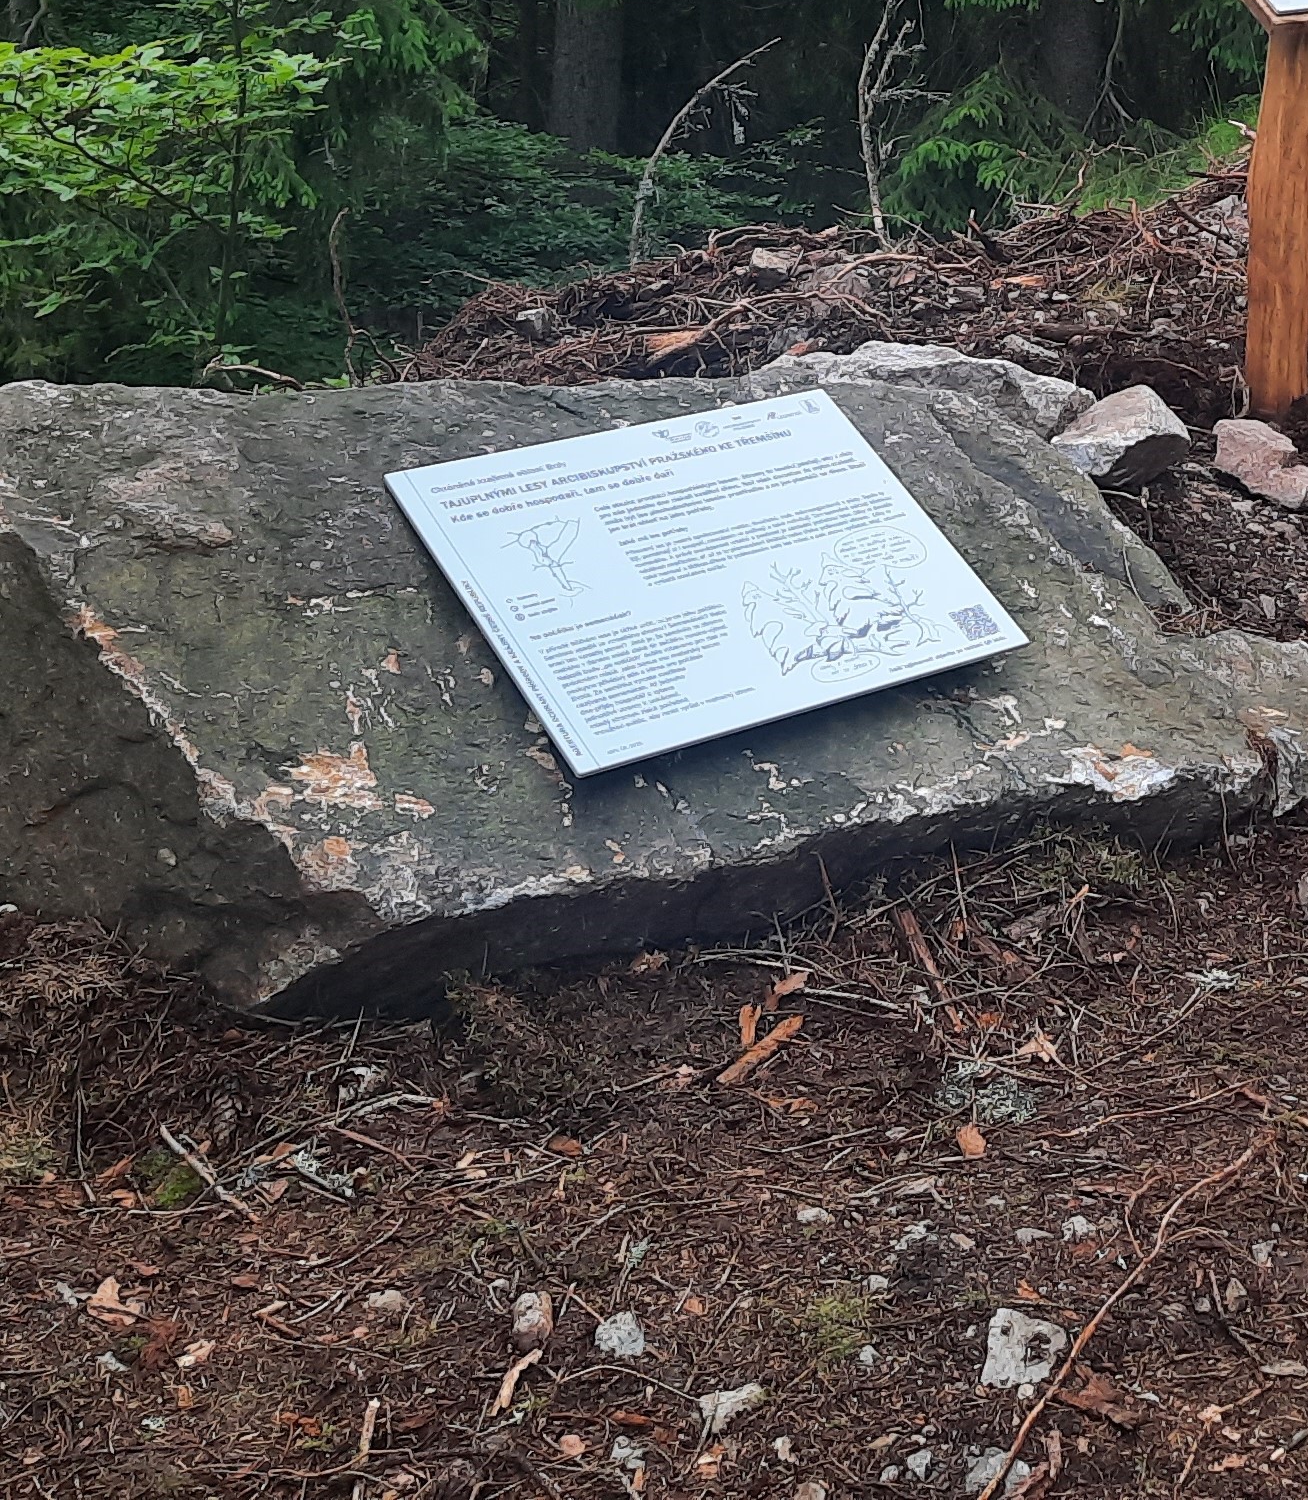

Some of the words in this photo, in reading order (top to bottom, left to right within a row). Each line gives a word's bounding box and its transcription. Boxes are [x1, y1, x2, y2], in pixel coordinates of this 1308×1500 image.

[439, 487, 517, 509] TAJUPLNÝMI
[517, 480, 547, 492] LESY
[551, 457, 647, 485] ARCIBISKUPSTVÍ
[648, 445, 716, 465] PRAŽSKÉHO
[734, 429, 791, 446] TŘEMŠÍNU
[450, 513, 473, 523] Kde
[491, 502, 523, 514] dobře
[621, 475, 651, 485] dobře
[653, 468, 674, 479] daří
